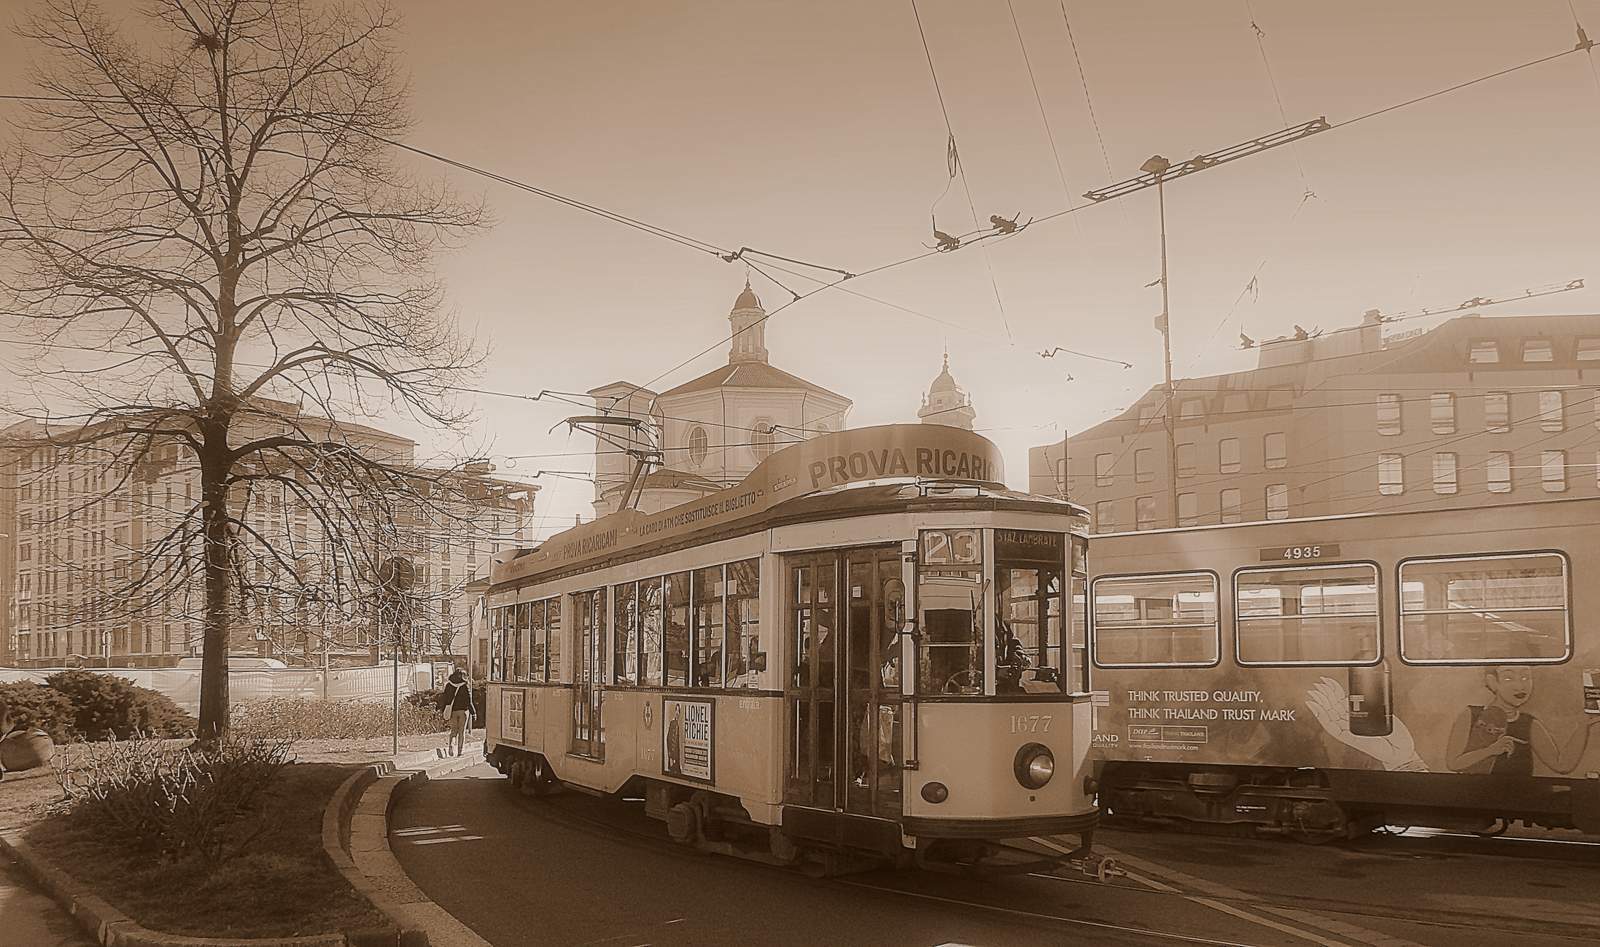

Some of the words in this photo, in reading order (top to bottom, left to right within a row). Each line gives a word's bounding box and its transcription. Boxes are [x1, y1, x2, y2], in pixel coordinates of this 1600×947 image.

[808, 448, 910, 489] PROVA
[684, 503, 719, 524] SOSTITUISCE
[725, 491, 756, 513] BIGLIETTO
[1283, 545, 1321, 559] 4935
[1127, 690, 1160, 702] THINK
[1163, 691, 1209, 703] TRUSTED
[1212, 691, 1264, 704] QUALITY.
[685, 705, 709, 723] LIONEL
[1127, 708, 1160, 720] THINK
[1163, 708, 1218, 721] THAILAND
[1221, 709, 1256, 721] TRUST
[1259, 709, 1296, 722] MARK
[685, 722, 709, 741] RICHIE
[1010, 715, 1052, 733] 1677
[1092, 734, 1119, 742] AND
